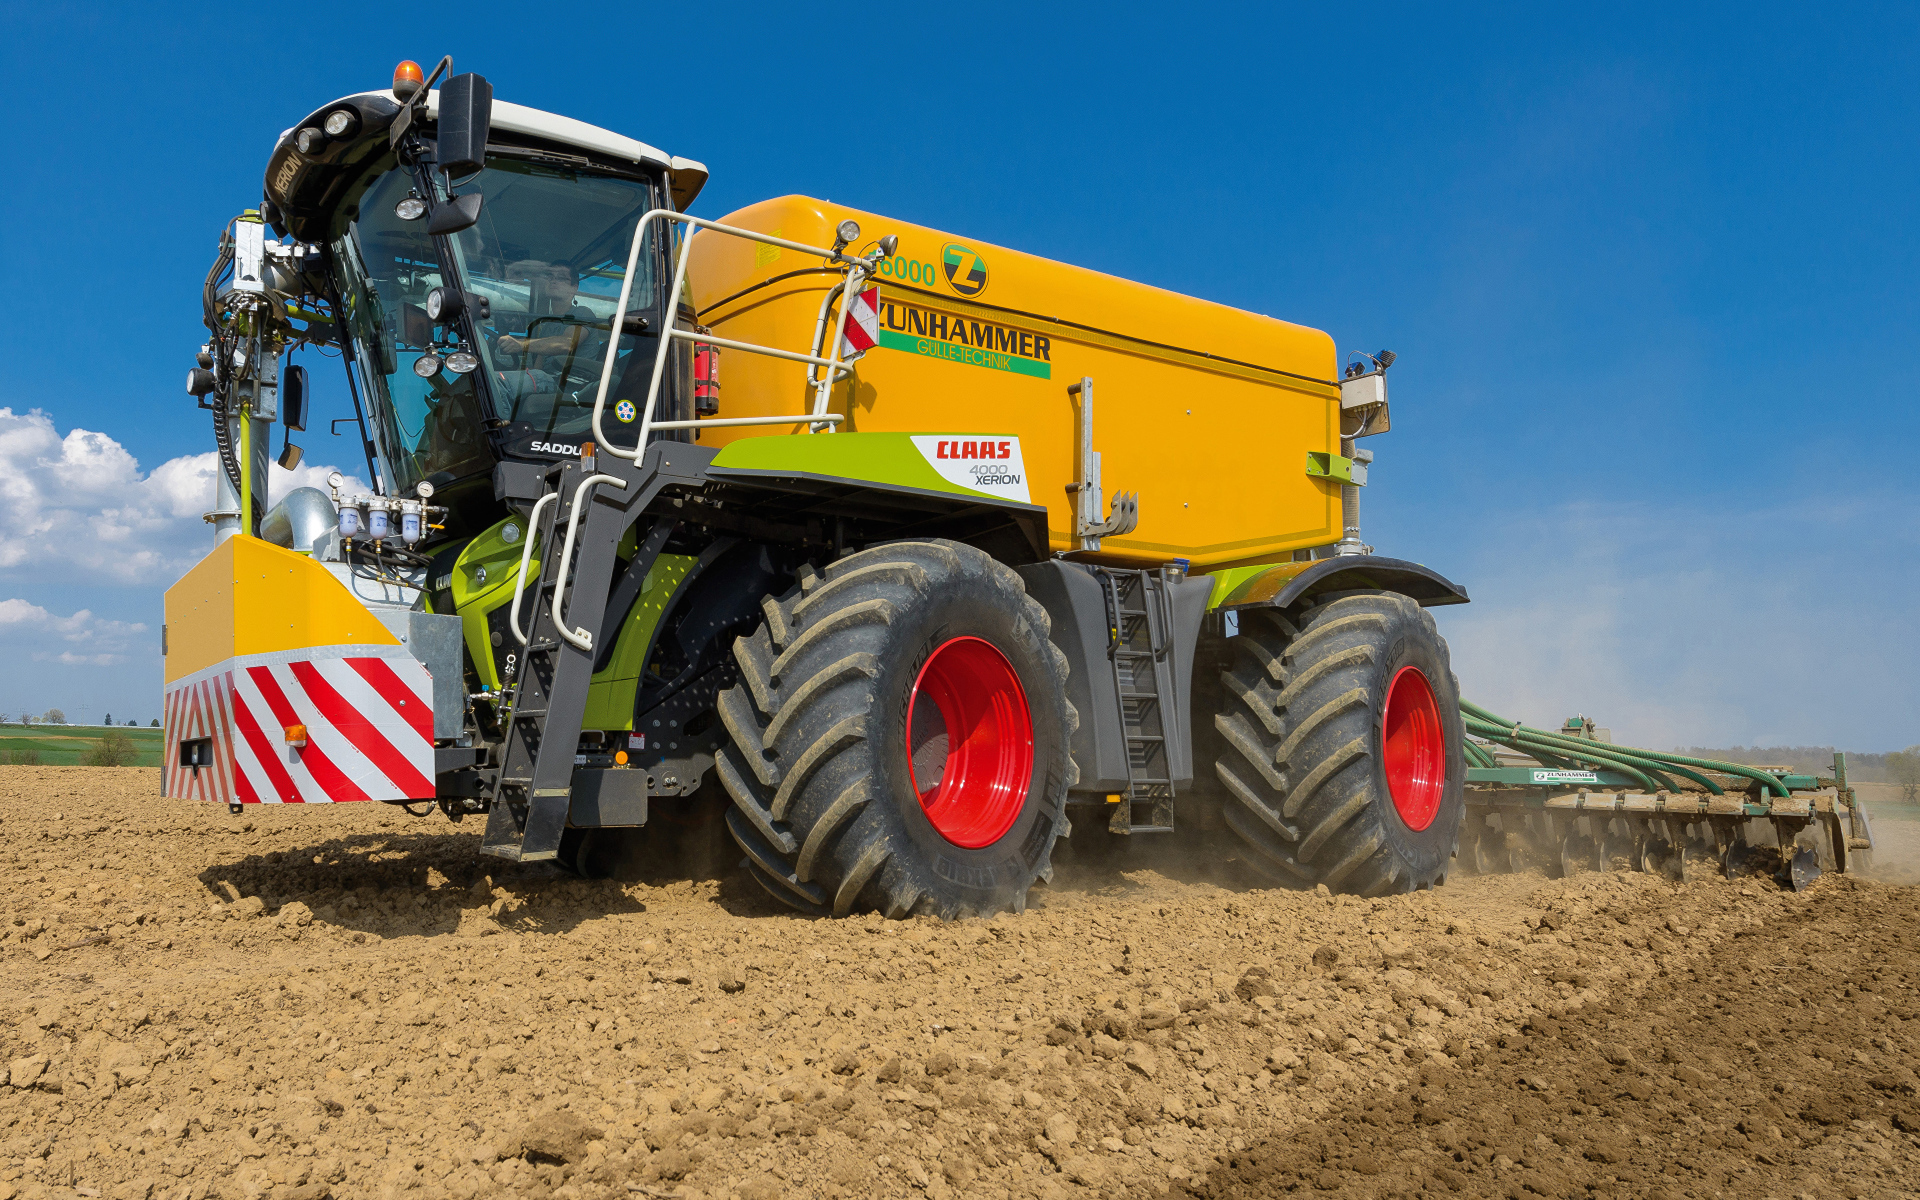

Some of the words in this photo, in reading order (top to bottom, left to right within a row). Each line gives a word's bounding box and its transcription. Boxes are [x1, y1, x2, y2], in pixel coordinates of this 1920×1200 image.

[274, 151, 302, 197] XERION
[869, 250, 936, 287] 6000
[917, 339, 1011, 371] GÜLLE-TECHNIK
[530, 441, 582, 456] SADDL
[936, 441, 1011, 459] CLAAS
[969, 464, 1008, 476] 4000
[975, 474, 1021, 486] XERION
